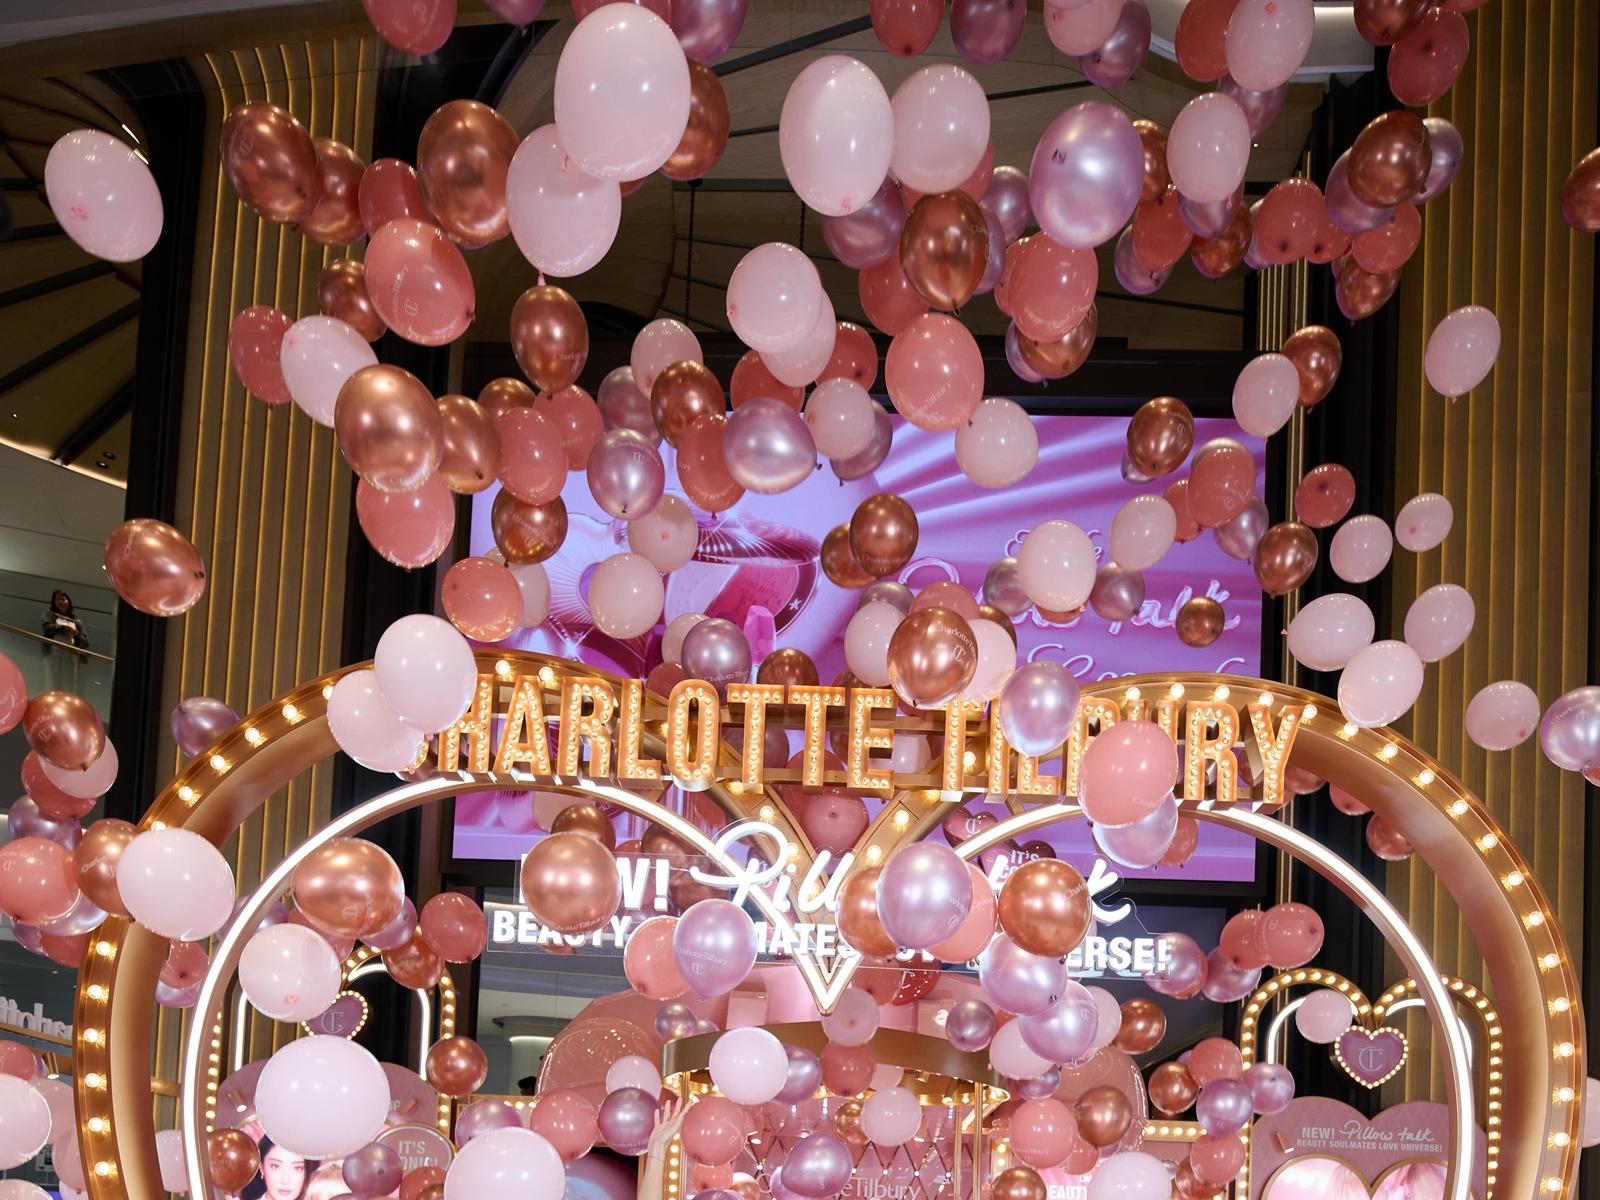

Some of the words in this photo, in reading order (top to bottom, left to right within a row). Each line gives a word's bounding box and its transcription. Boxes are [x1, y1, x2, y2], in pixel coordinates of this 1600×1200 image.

[411, 674, 897, 791] HARLOTTE
[1302, 1126, 1335, 1139] NEW!
[1339, 1120, 1393, 1141] Pillow
[1397, 1127, 1435, 1142] talk
[398, 1140, 426, 1154] IT'S
[1296, 1139, 1327, 1147] BEAUTY
[1329, 1140, 1377, 1150] SOULMATES
[1378, 1142, 1398, 1151] LOVE
[1400, 1143, 1443, 1153] UNIVERSE!
